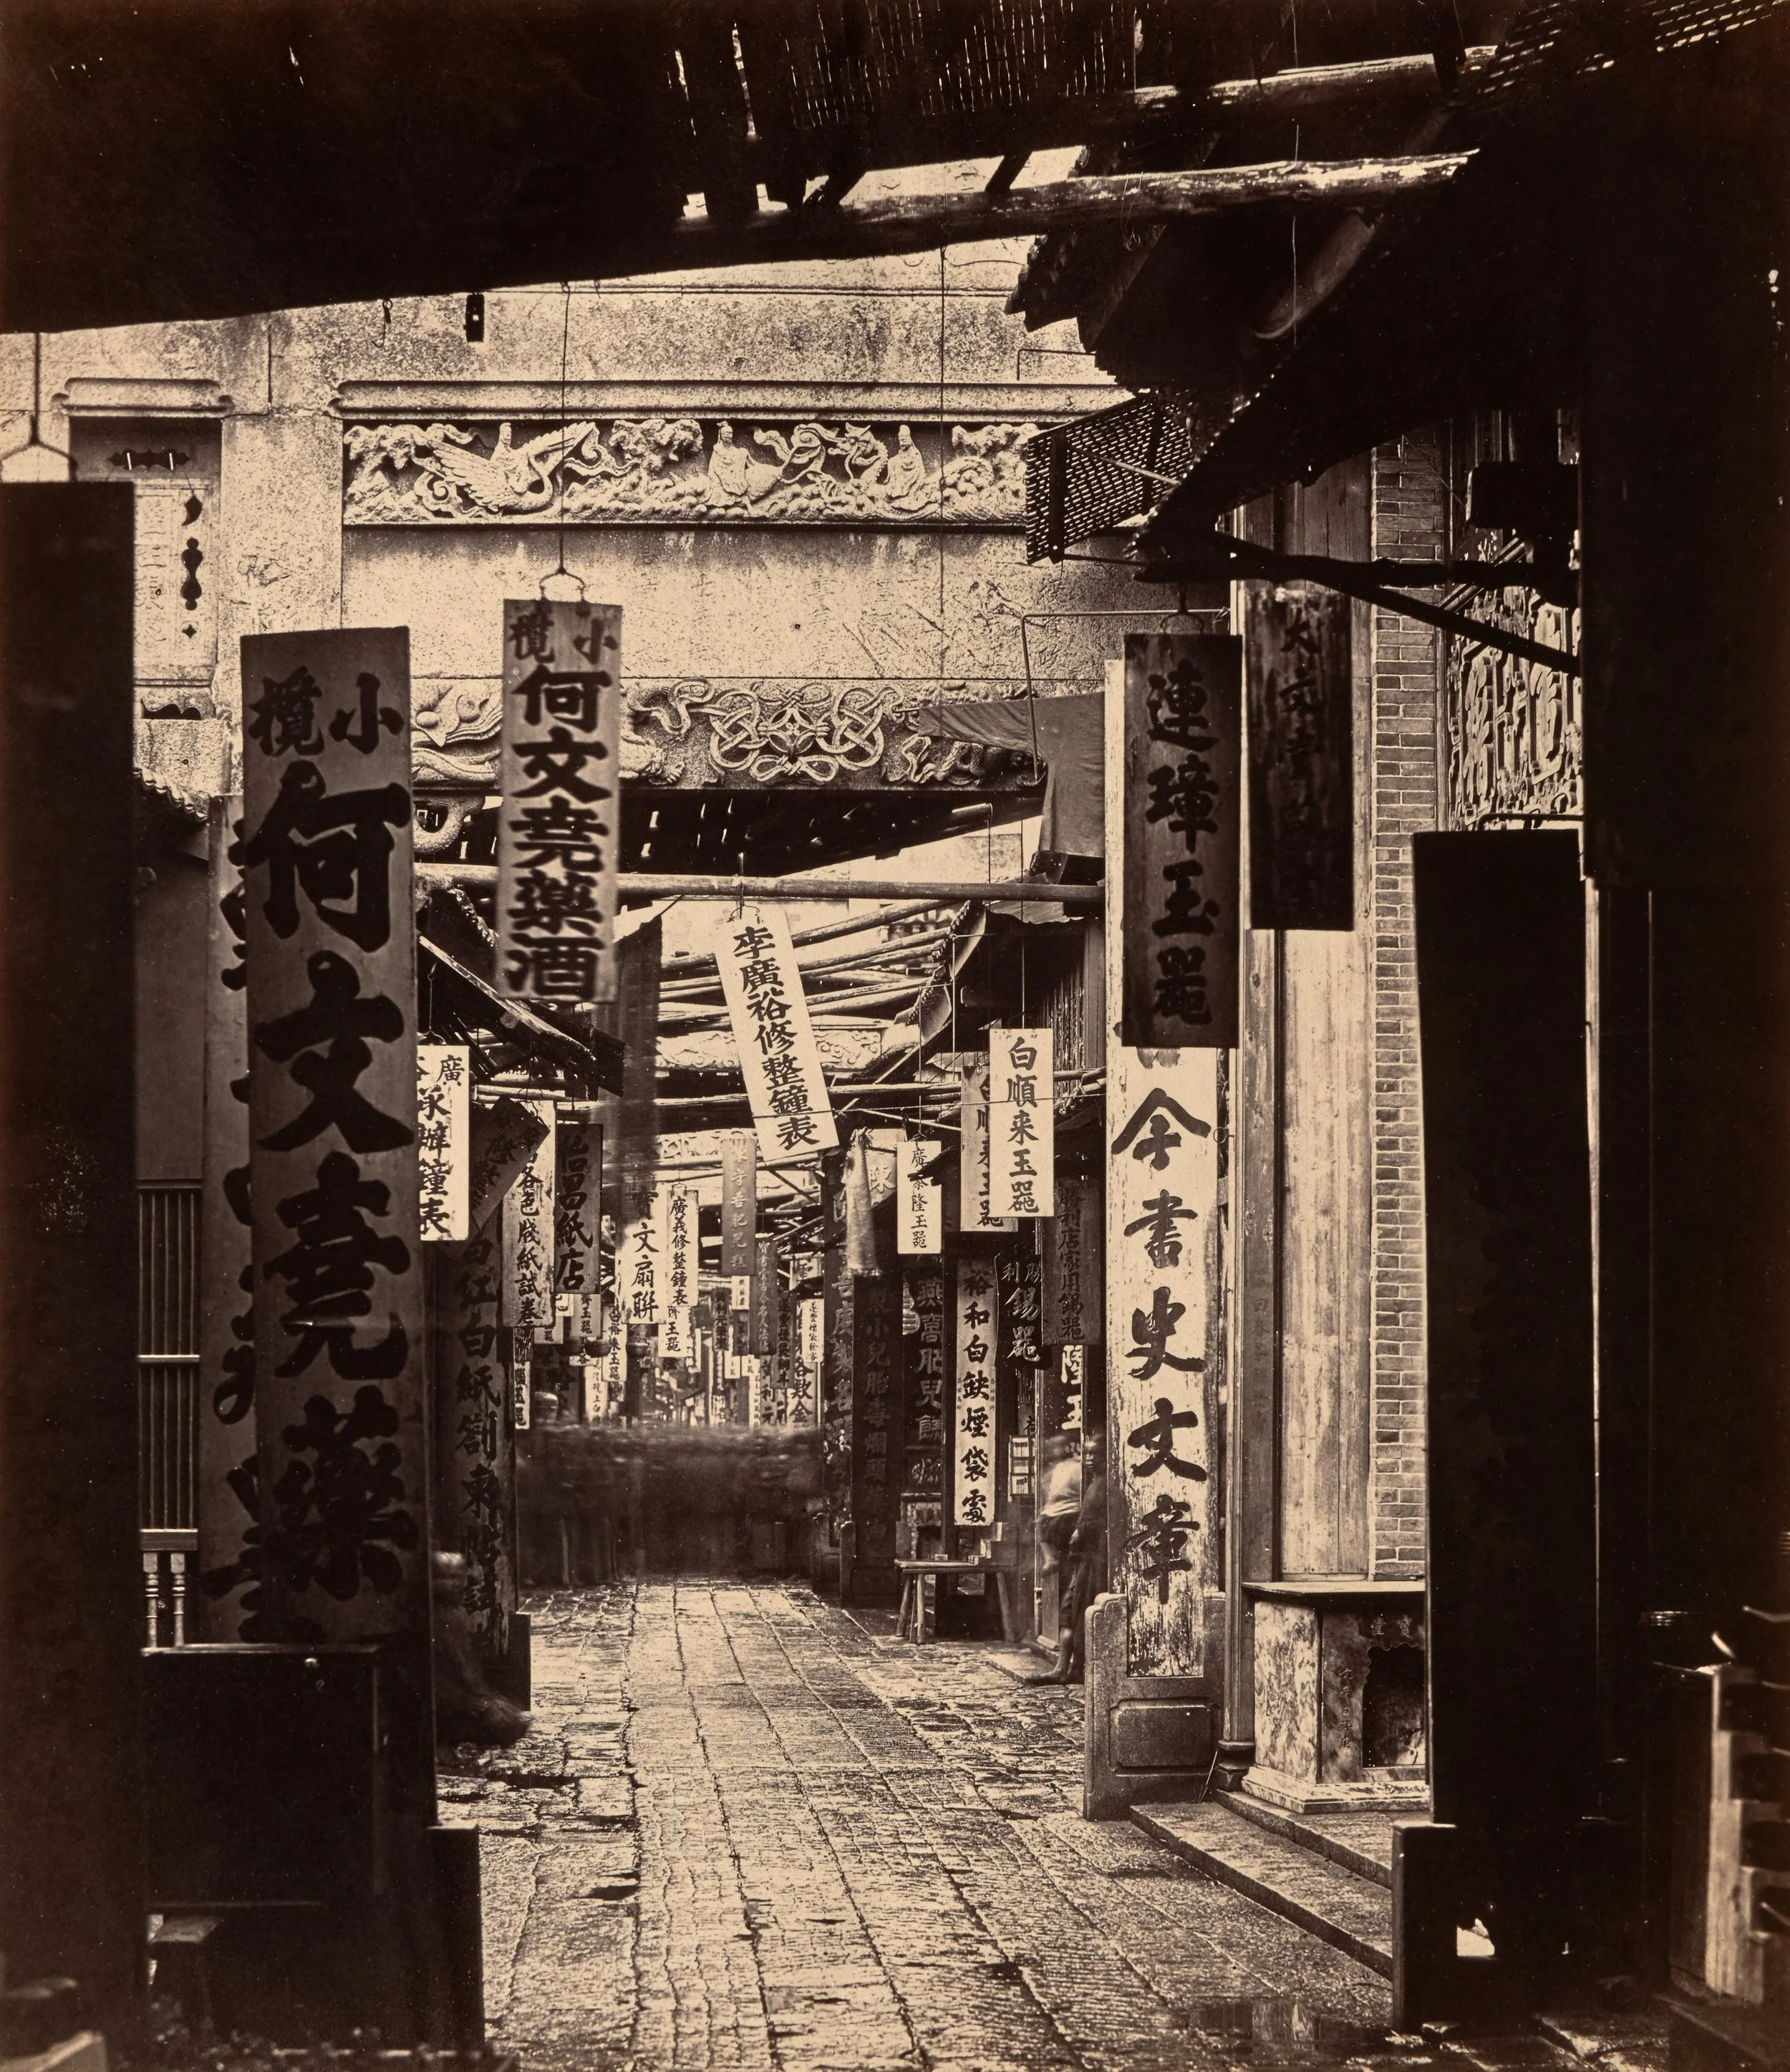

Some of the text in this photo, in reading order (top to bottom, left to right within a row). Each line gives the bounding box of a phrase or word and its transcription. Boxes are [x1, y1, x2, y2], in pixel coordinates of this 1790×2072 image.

[514, 1151, 543, 1325] 各色牋紙試卷
